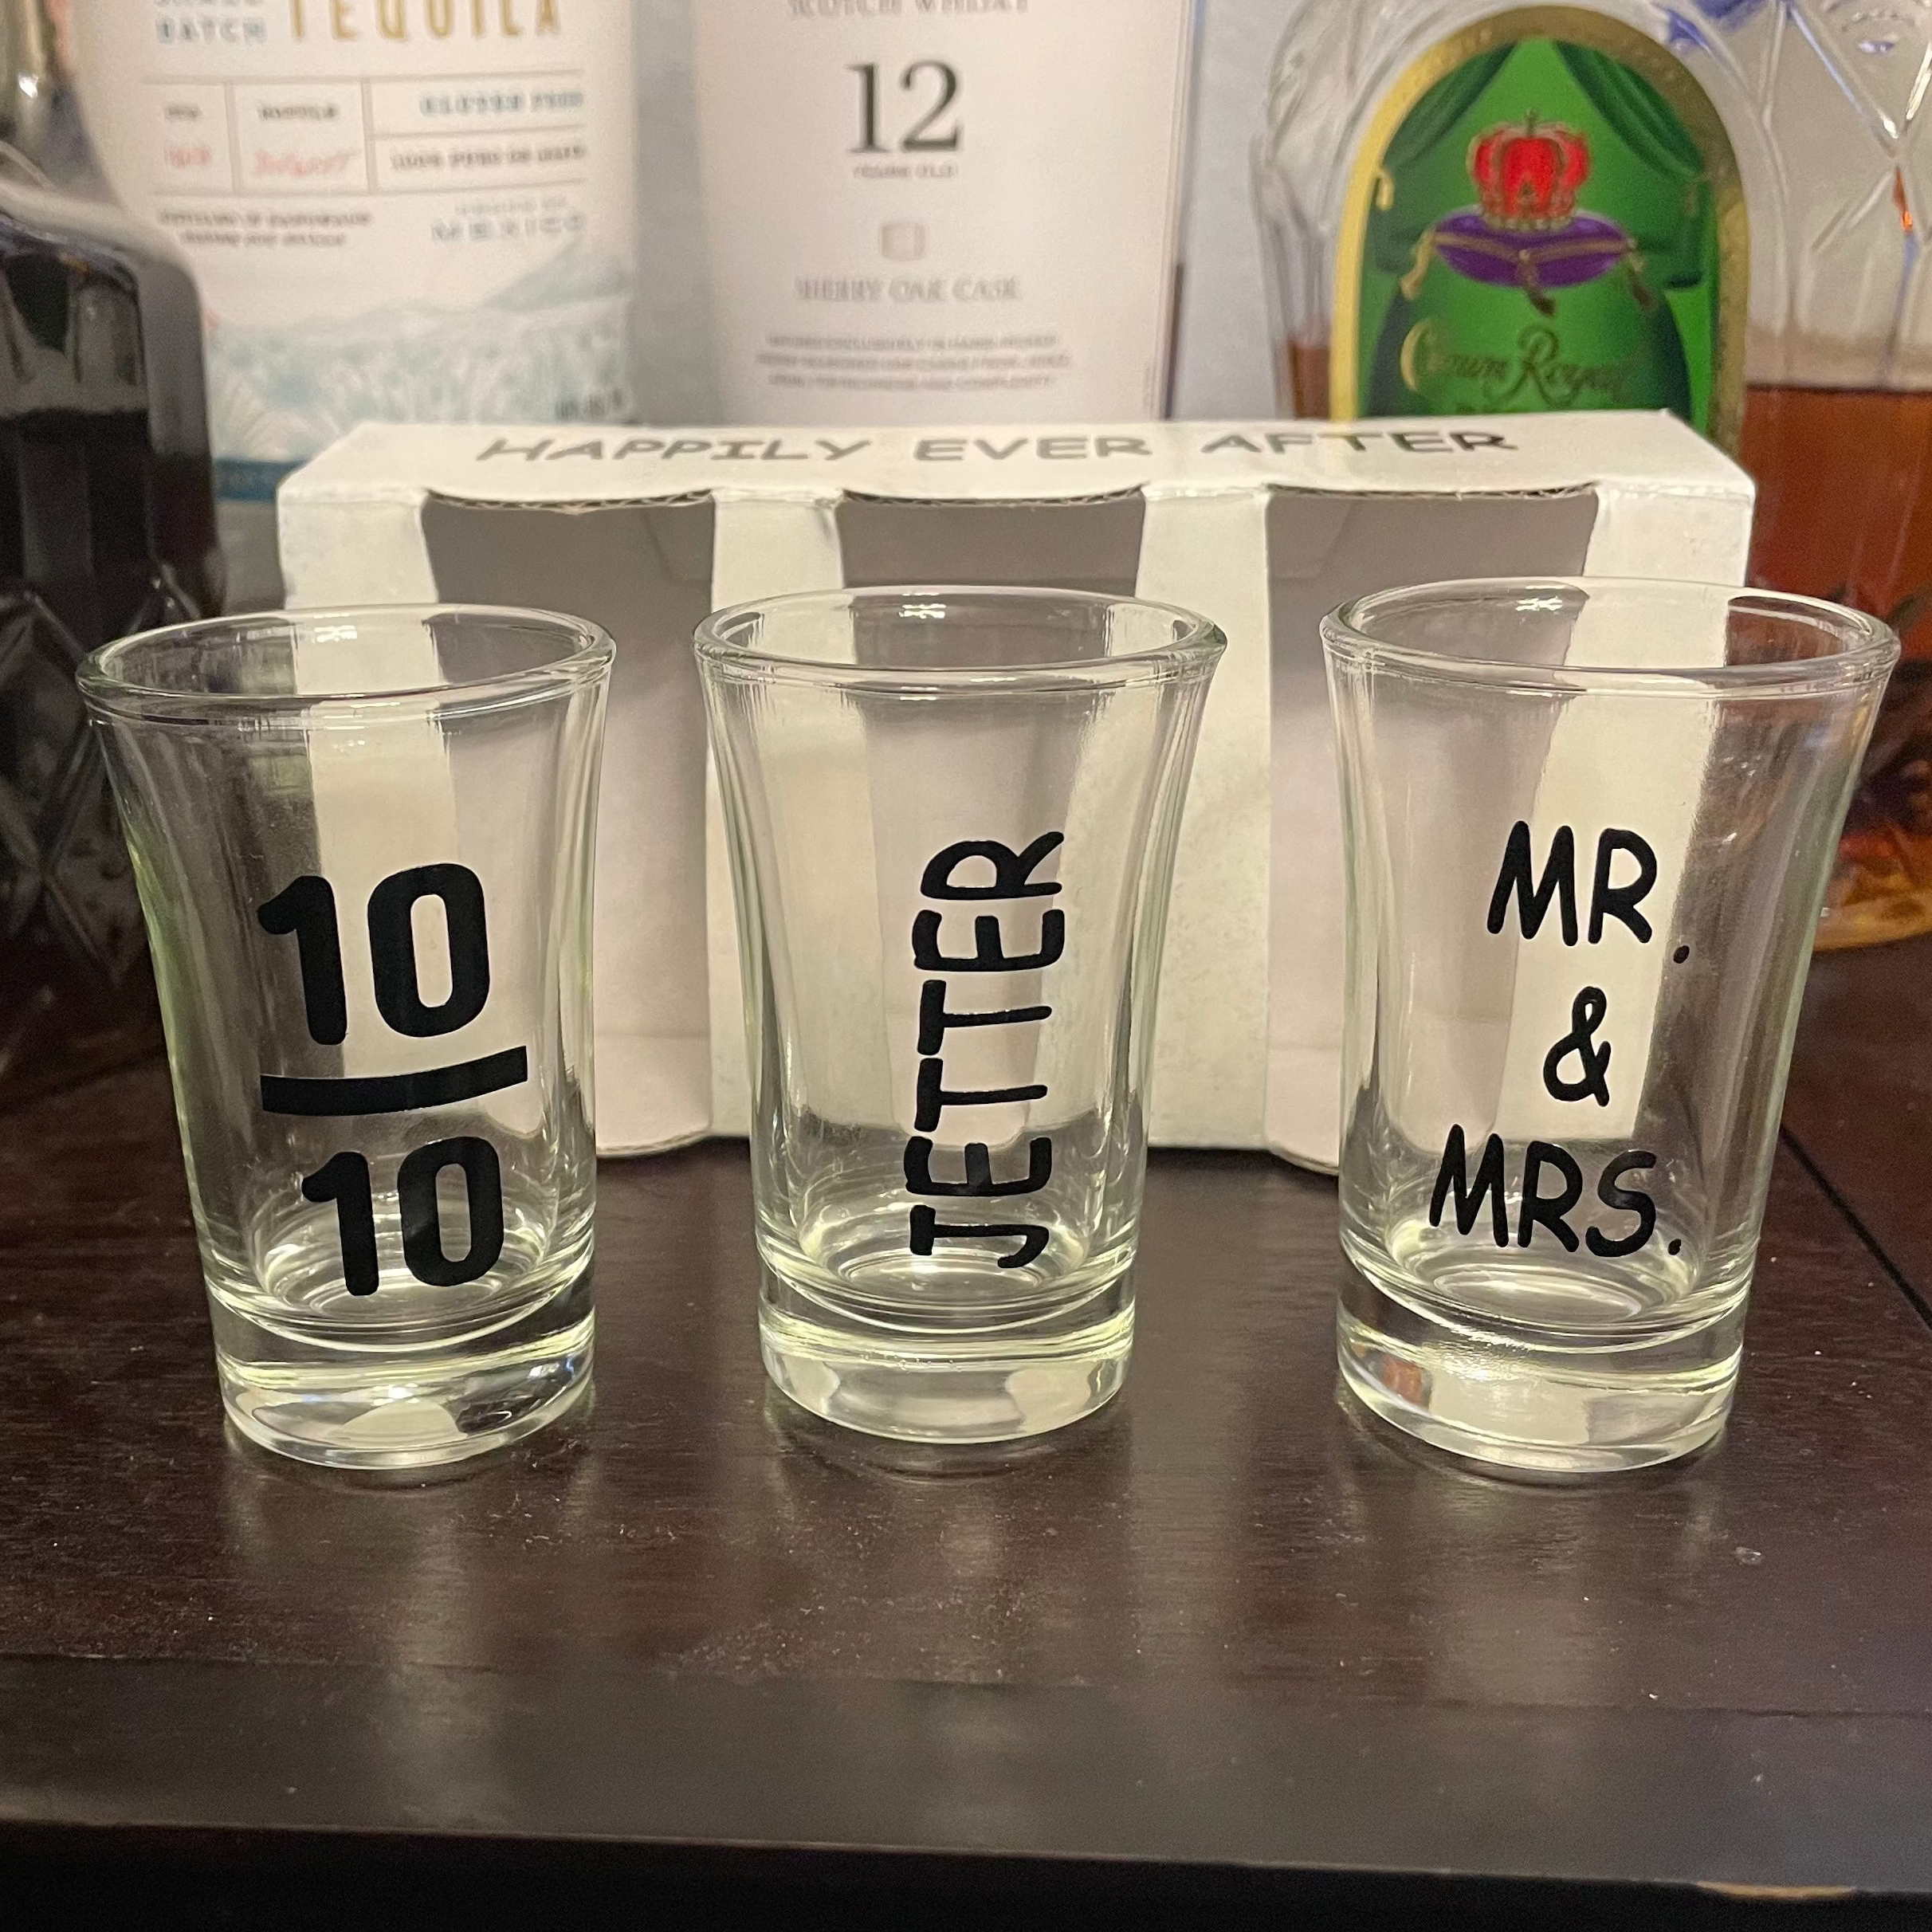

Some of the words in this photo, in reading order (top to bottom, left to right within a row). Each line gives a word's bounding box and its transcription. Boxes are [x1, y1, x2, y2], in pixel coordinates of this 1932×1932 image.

[845, 59, 964, 154] 12
[476, 438, 871, 461] HAPPILY
[913, 435, 1153, 461] EVER
[1200, 431, 1518, 454] AFTER
[257, 862, 491, 1046] 10
[1486, 820, 1690, 964] MR.
[903, 831, 1066, 1269] JETTER
[1543, 986, 1612, 1107] &
[300, 1136, 505, 1297] 10
[1428, 1123, 1682, 1258] MRS.
